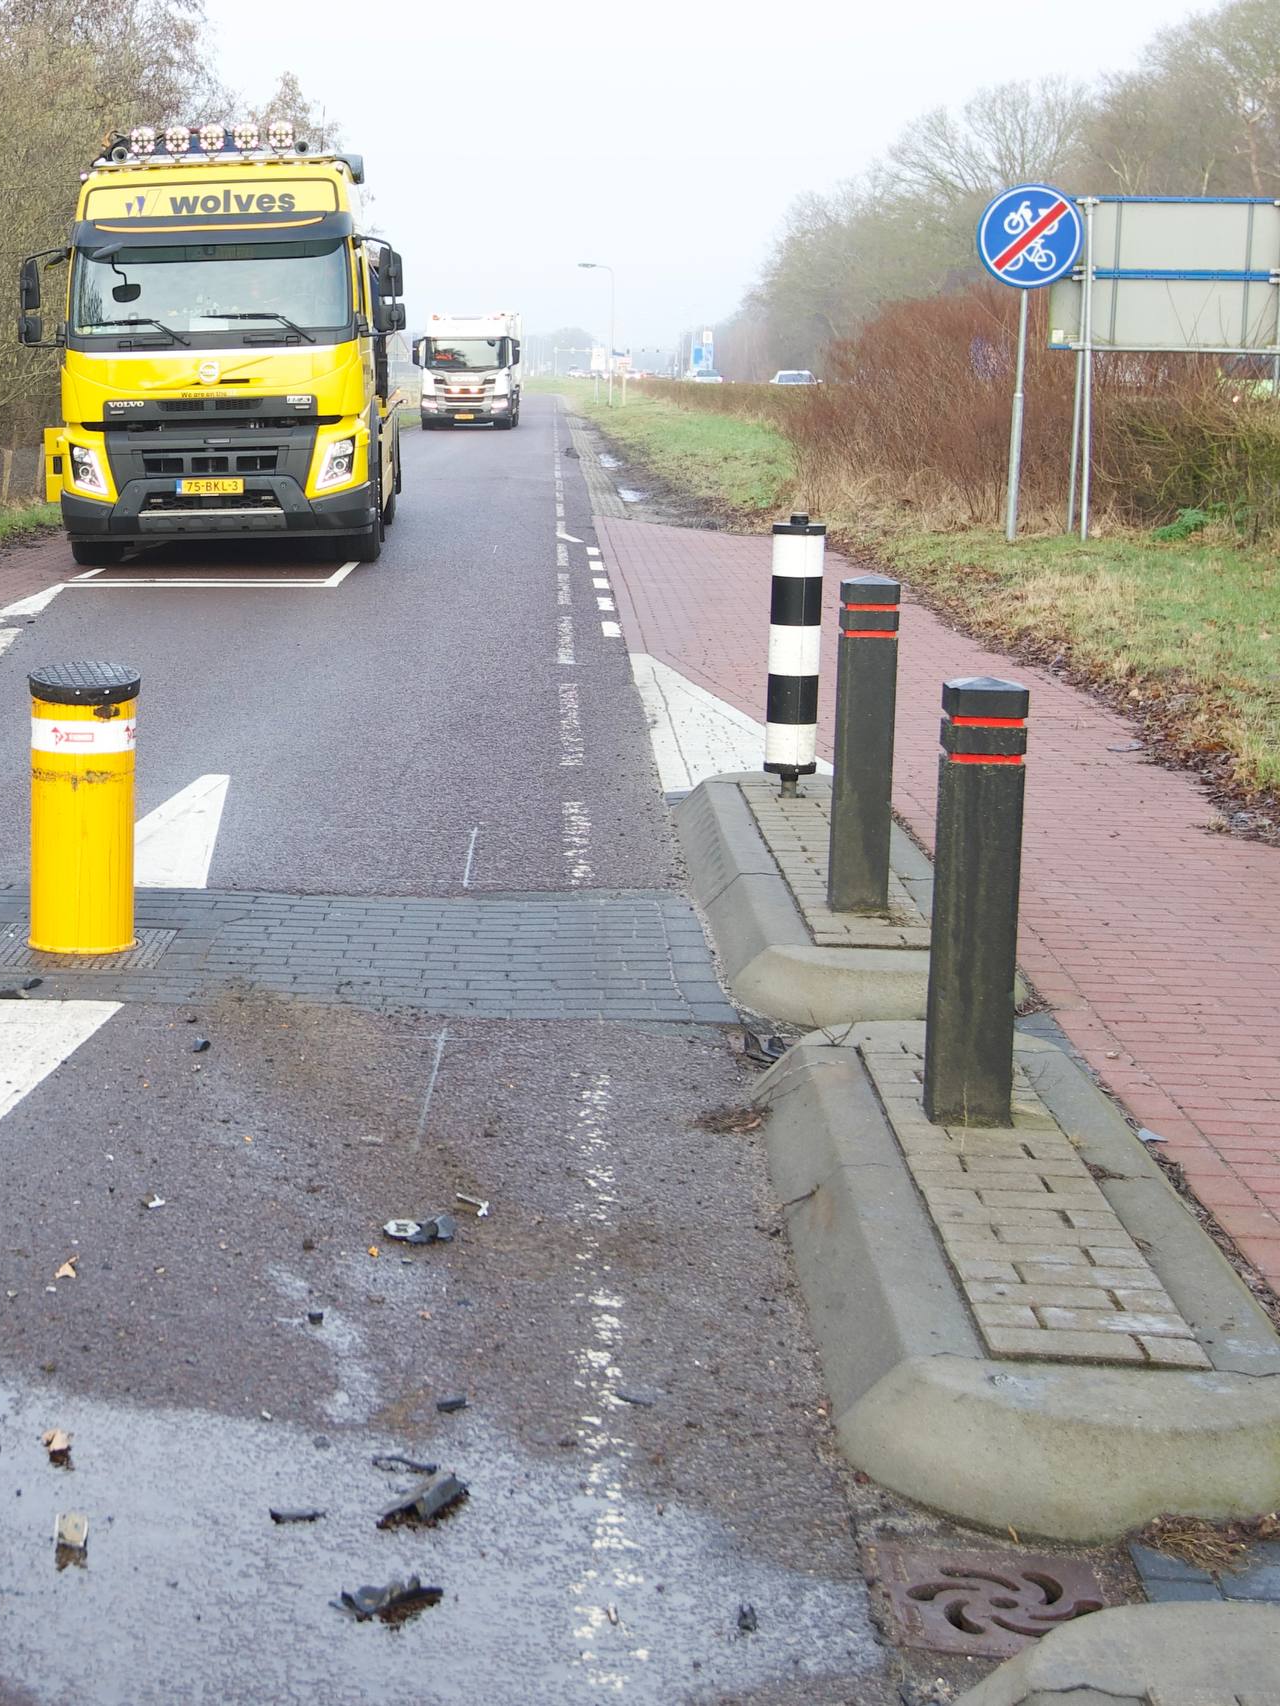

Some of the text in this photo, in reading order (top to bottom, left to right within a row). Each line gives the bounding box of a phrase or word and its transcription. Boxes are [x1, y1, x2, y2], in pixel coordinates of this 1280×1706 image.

[170, 189, 296, 215] wolves
[108, 400, 145, 408] VOLVO
[186, 481, 238, 492] 75-BKL-3
